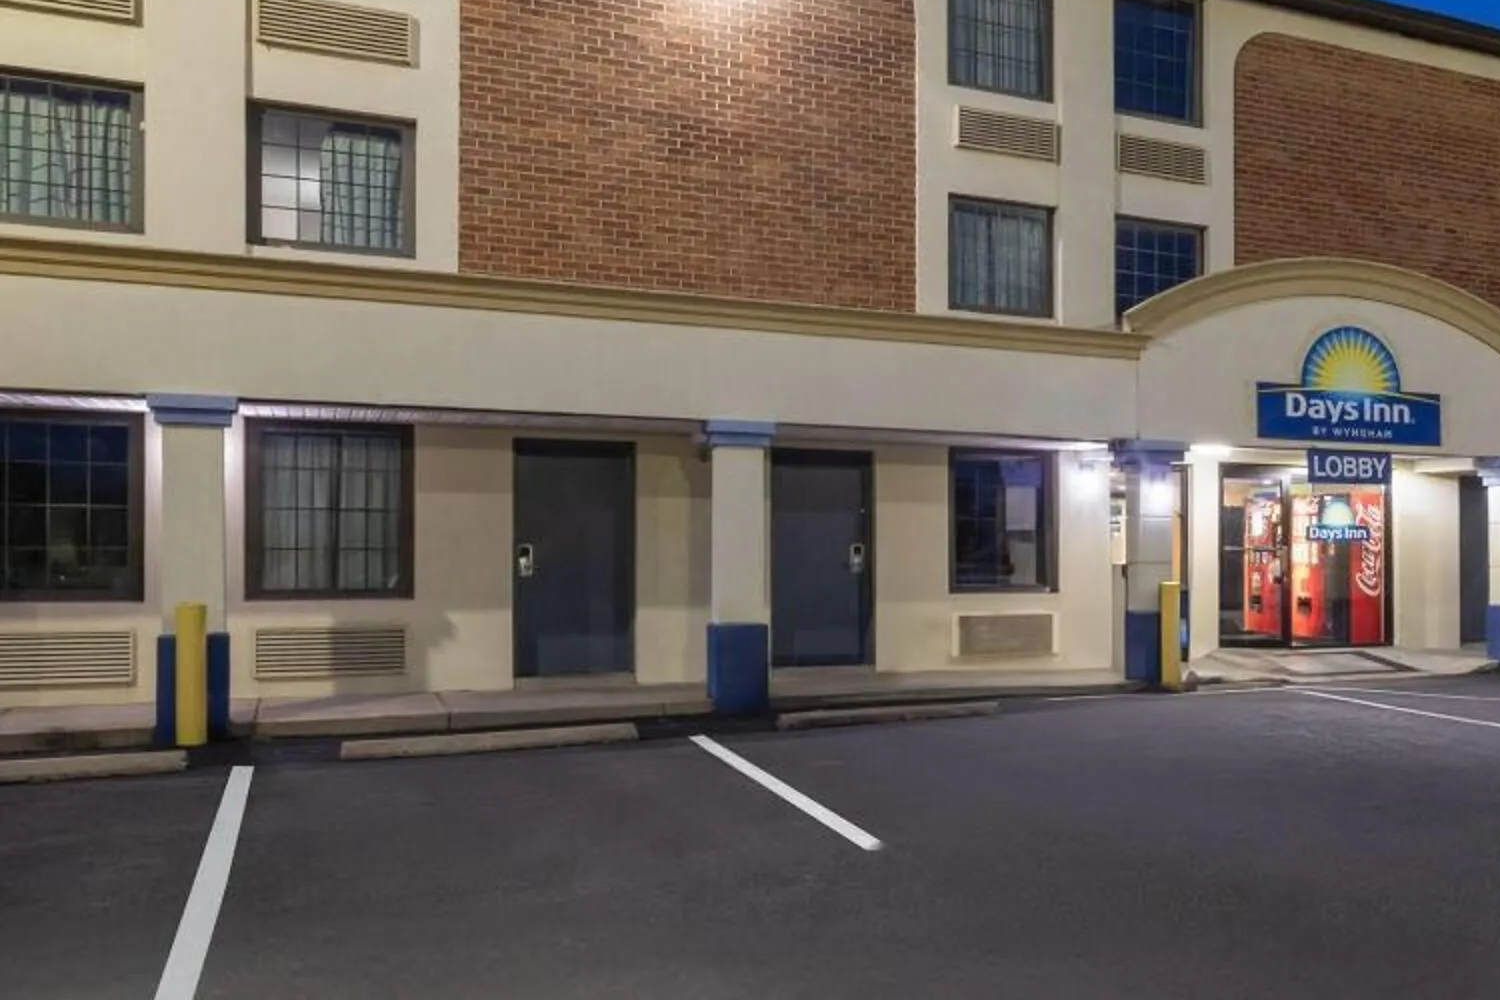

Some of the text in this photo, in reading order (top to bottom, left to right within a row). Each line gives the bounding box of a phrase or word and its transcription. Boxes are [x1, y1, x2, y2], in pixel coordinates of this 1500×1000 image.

[1285, 391, 1412, 425] Days Inn
[1313, 455, 1387, 479] LOBBY
[1309, 527, 1367, 541] Days Inn
[1355, 503, 1381, 597] CocaCola
